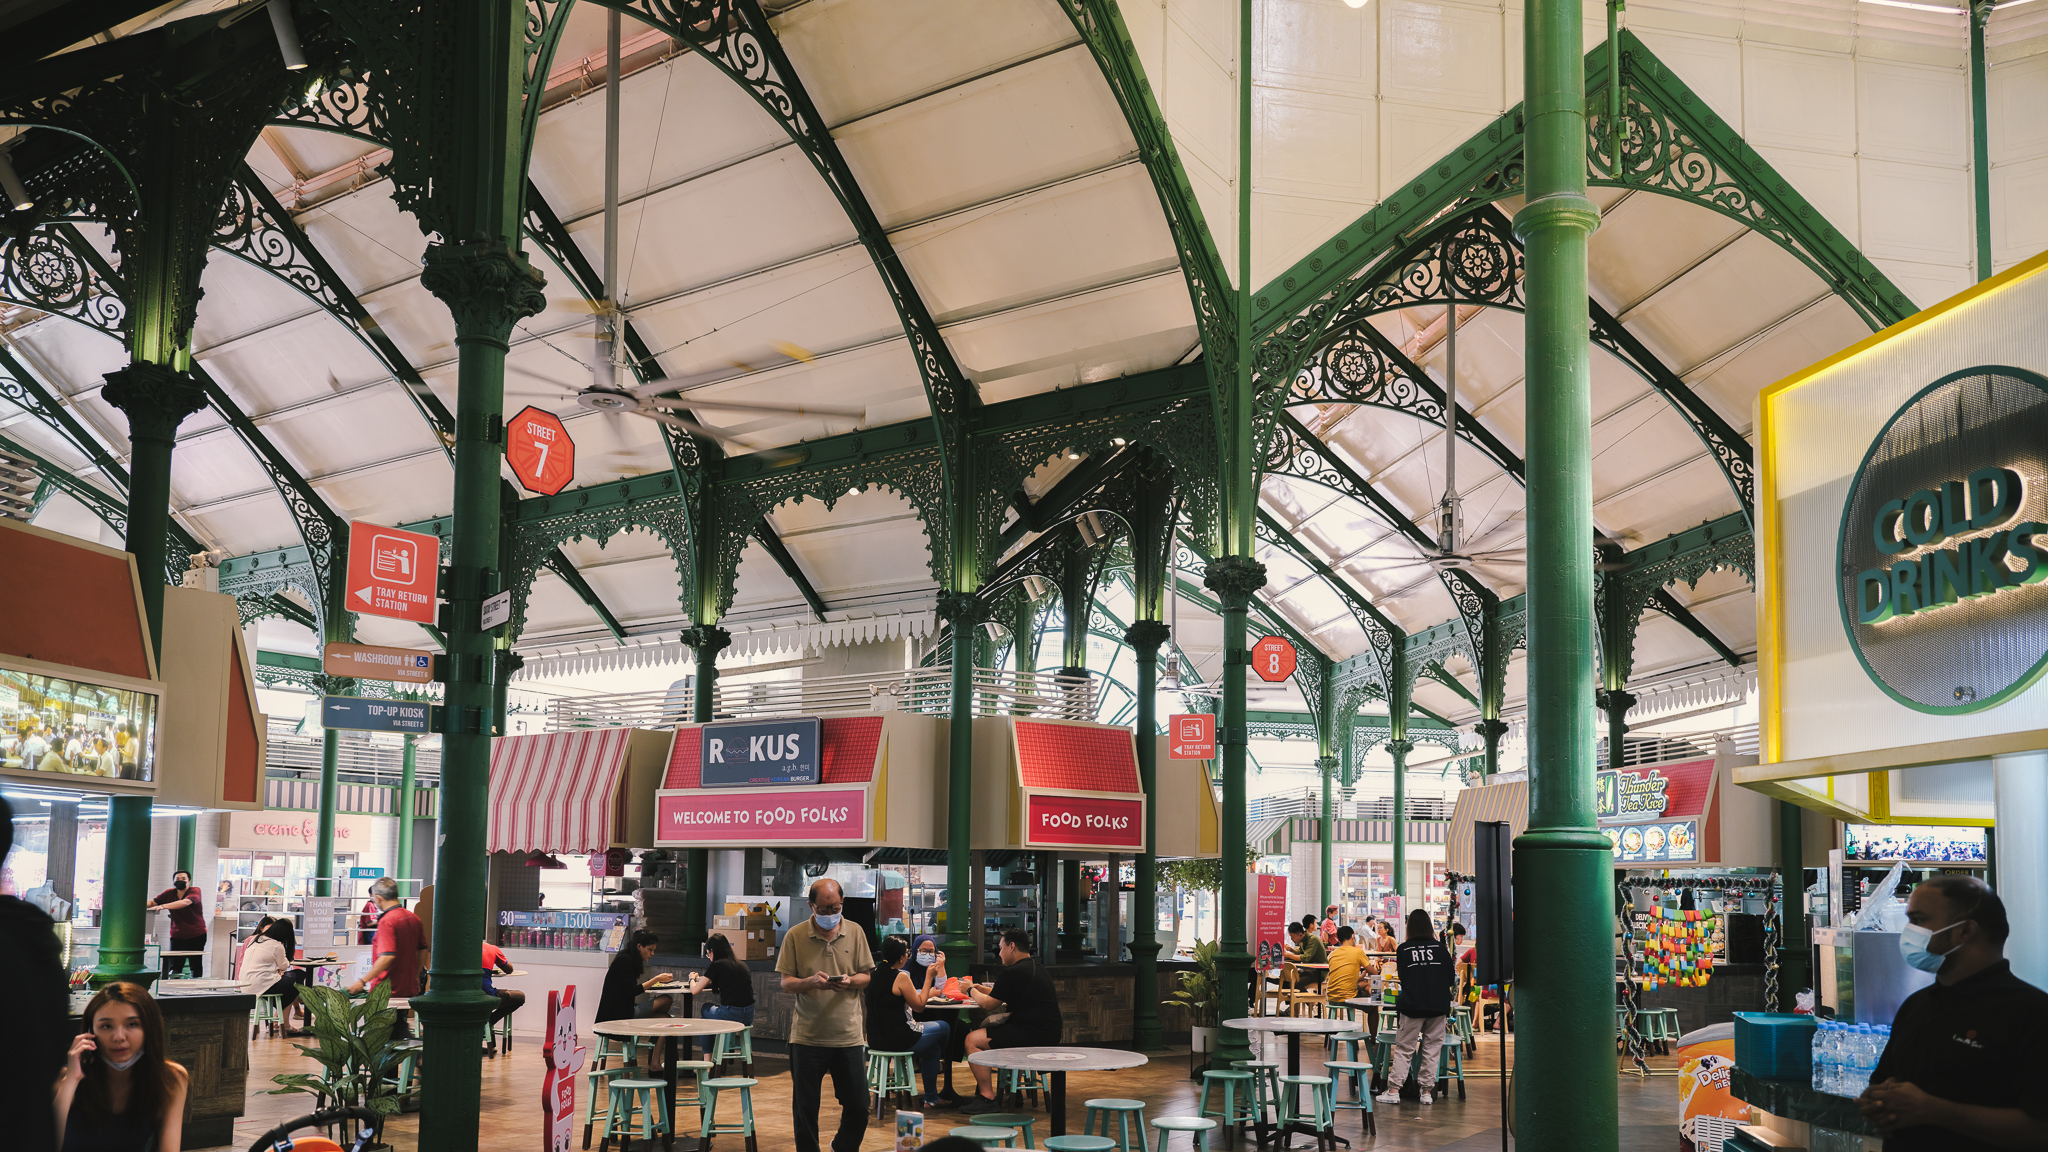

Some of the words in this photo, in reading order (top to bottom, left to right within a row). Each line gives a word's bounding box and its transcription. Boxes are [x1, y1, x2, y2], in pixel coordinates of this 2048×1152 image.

[527, 422, 556, 441] STREET
[534, 441, 549, 477] 7
[1873, 467, 2011, 555] COLD
[1857, 521, 2043, 624] DRINKS
[375, 598, 407, 611] STATION
[376, 587, 397, 600] TRAY
[399, 590, 428, 604] RETURN
[1264, 644, 1284, 652] STREET
[354, 652, 402, 666] WASHROOM
[1269, 654, 1279, 674] 8
[368, 705, 398, 716] TOP-UP
[400, 707, 424, 718] KIOSK
[1620, 774, 1663, 795] Thunder
[1621, 795, 1639, 811] Tea
[1640, 793, 1664, 810] Rice
[673, 810, 731, 825] WELCOME
[734, 810, 750, 824] TO
[755, 807, 796, 825] FOOD
[801, 806, 849, 824] FOLKS
[1042, 812, 1081, 829] FOOD
[1086, 814, 1129, 830] FOLKS
[255, 823, 300, 837] creme
[302, 819, 315, 844] &
[358, 868, 376, 877] HALAL
[501, 910, 514, 926] 30
[564, 912, 592, 928] 1500
[1411, 949, 1434, 961] RTS
[561, 1085, 572, 1100] FOOD
[1714, 1081, 1723, 1090] in
